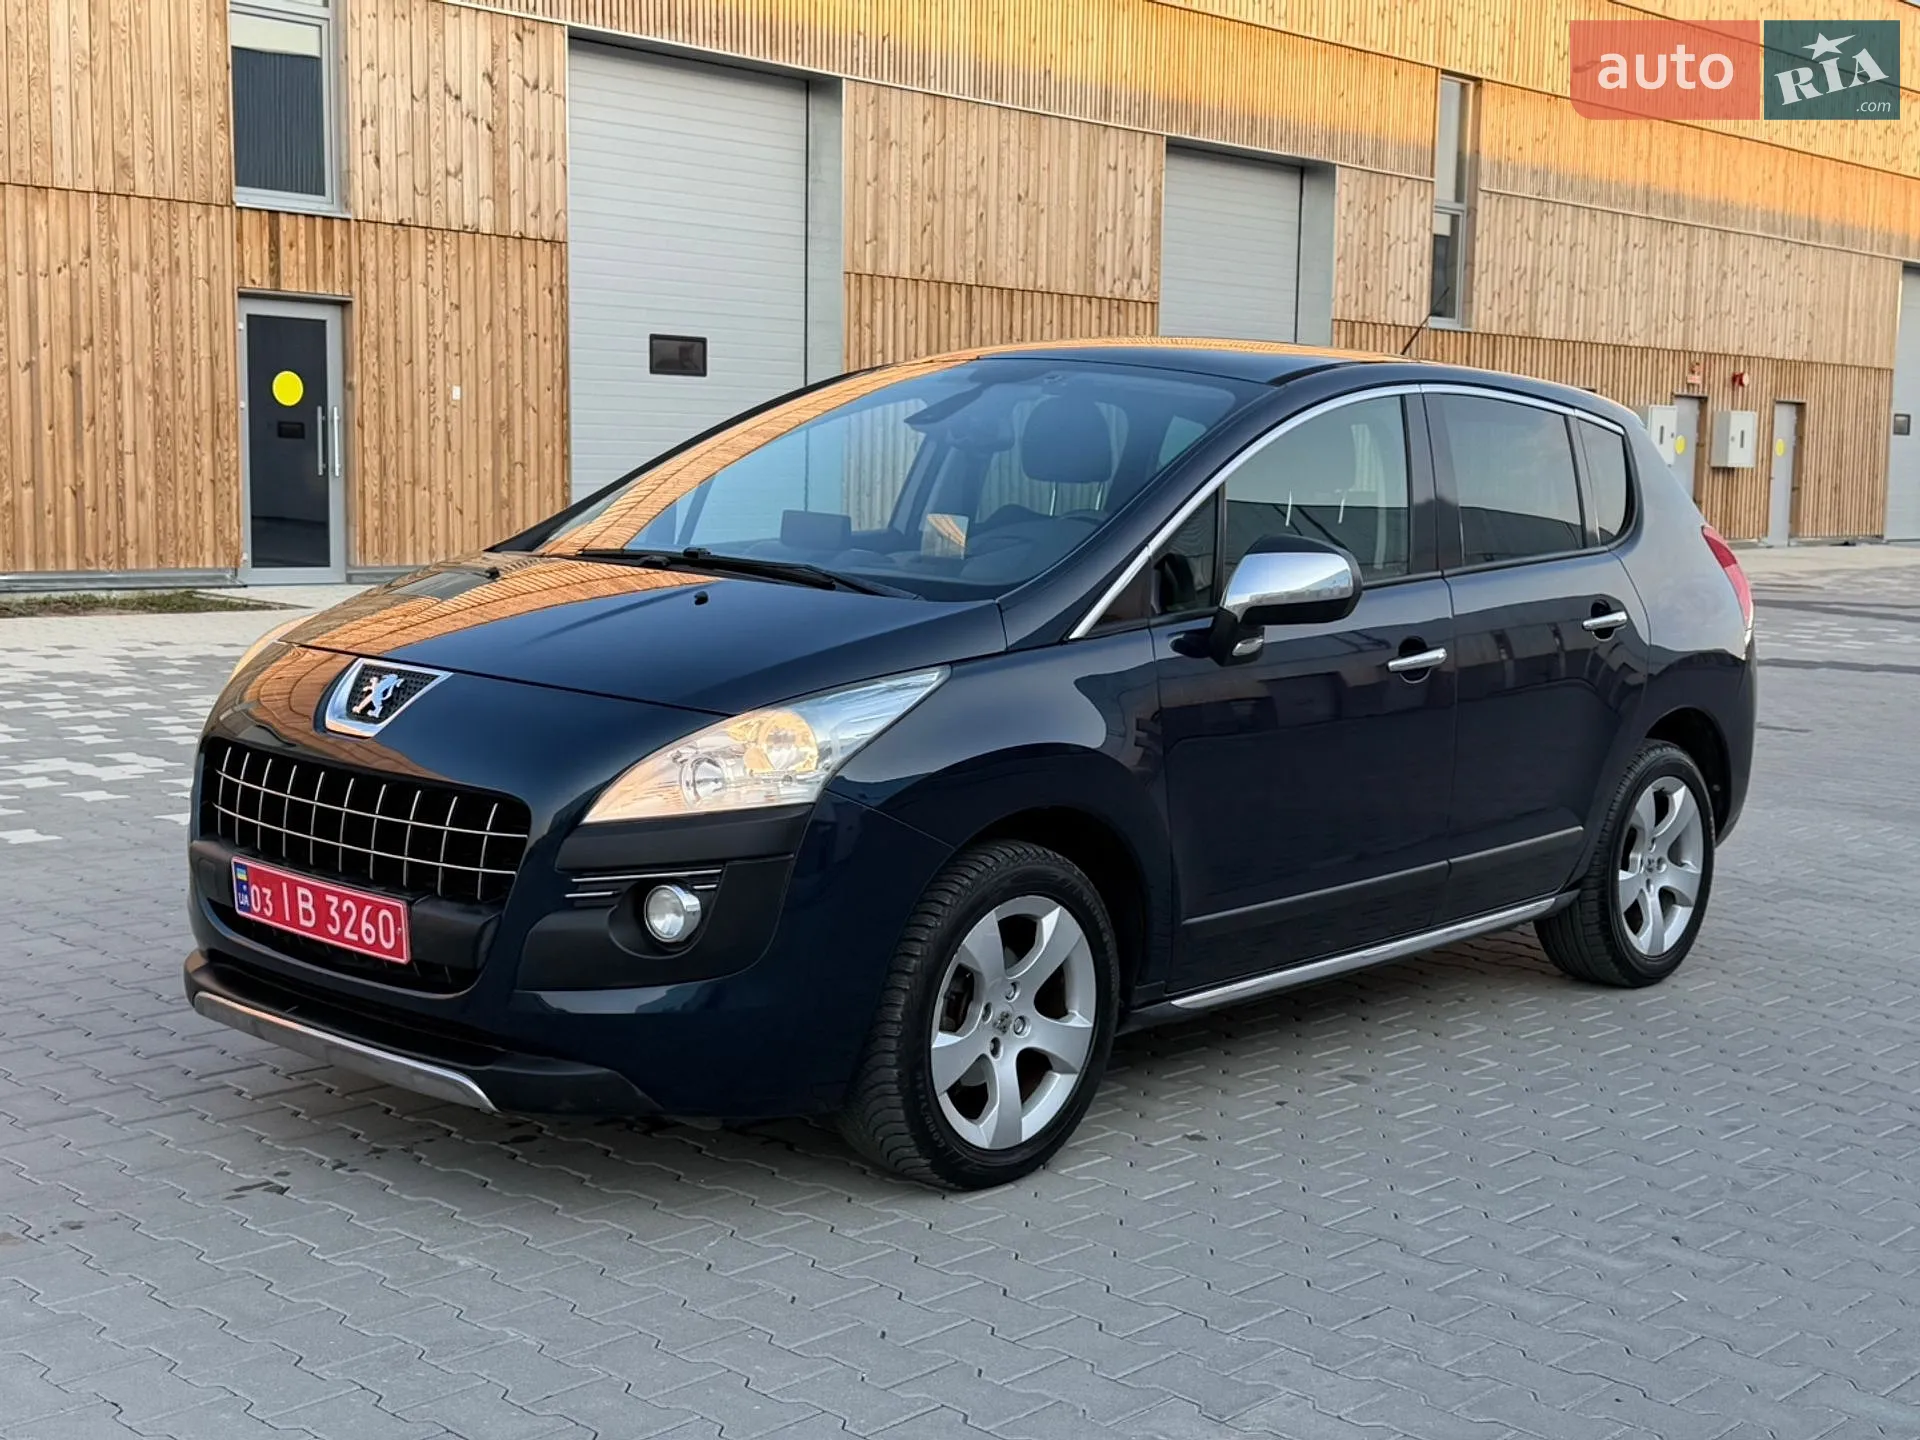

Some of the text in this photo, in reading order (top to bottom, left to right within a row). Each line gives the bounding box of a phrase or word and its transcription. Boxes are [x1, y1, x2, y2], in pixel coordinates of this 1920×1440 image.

[238, 892, 250, 907] UA
[251, 885, 273, 917] 03
[325, 894, 395, 950] 3260
